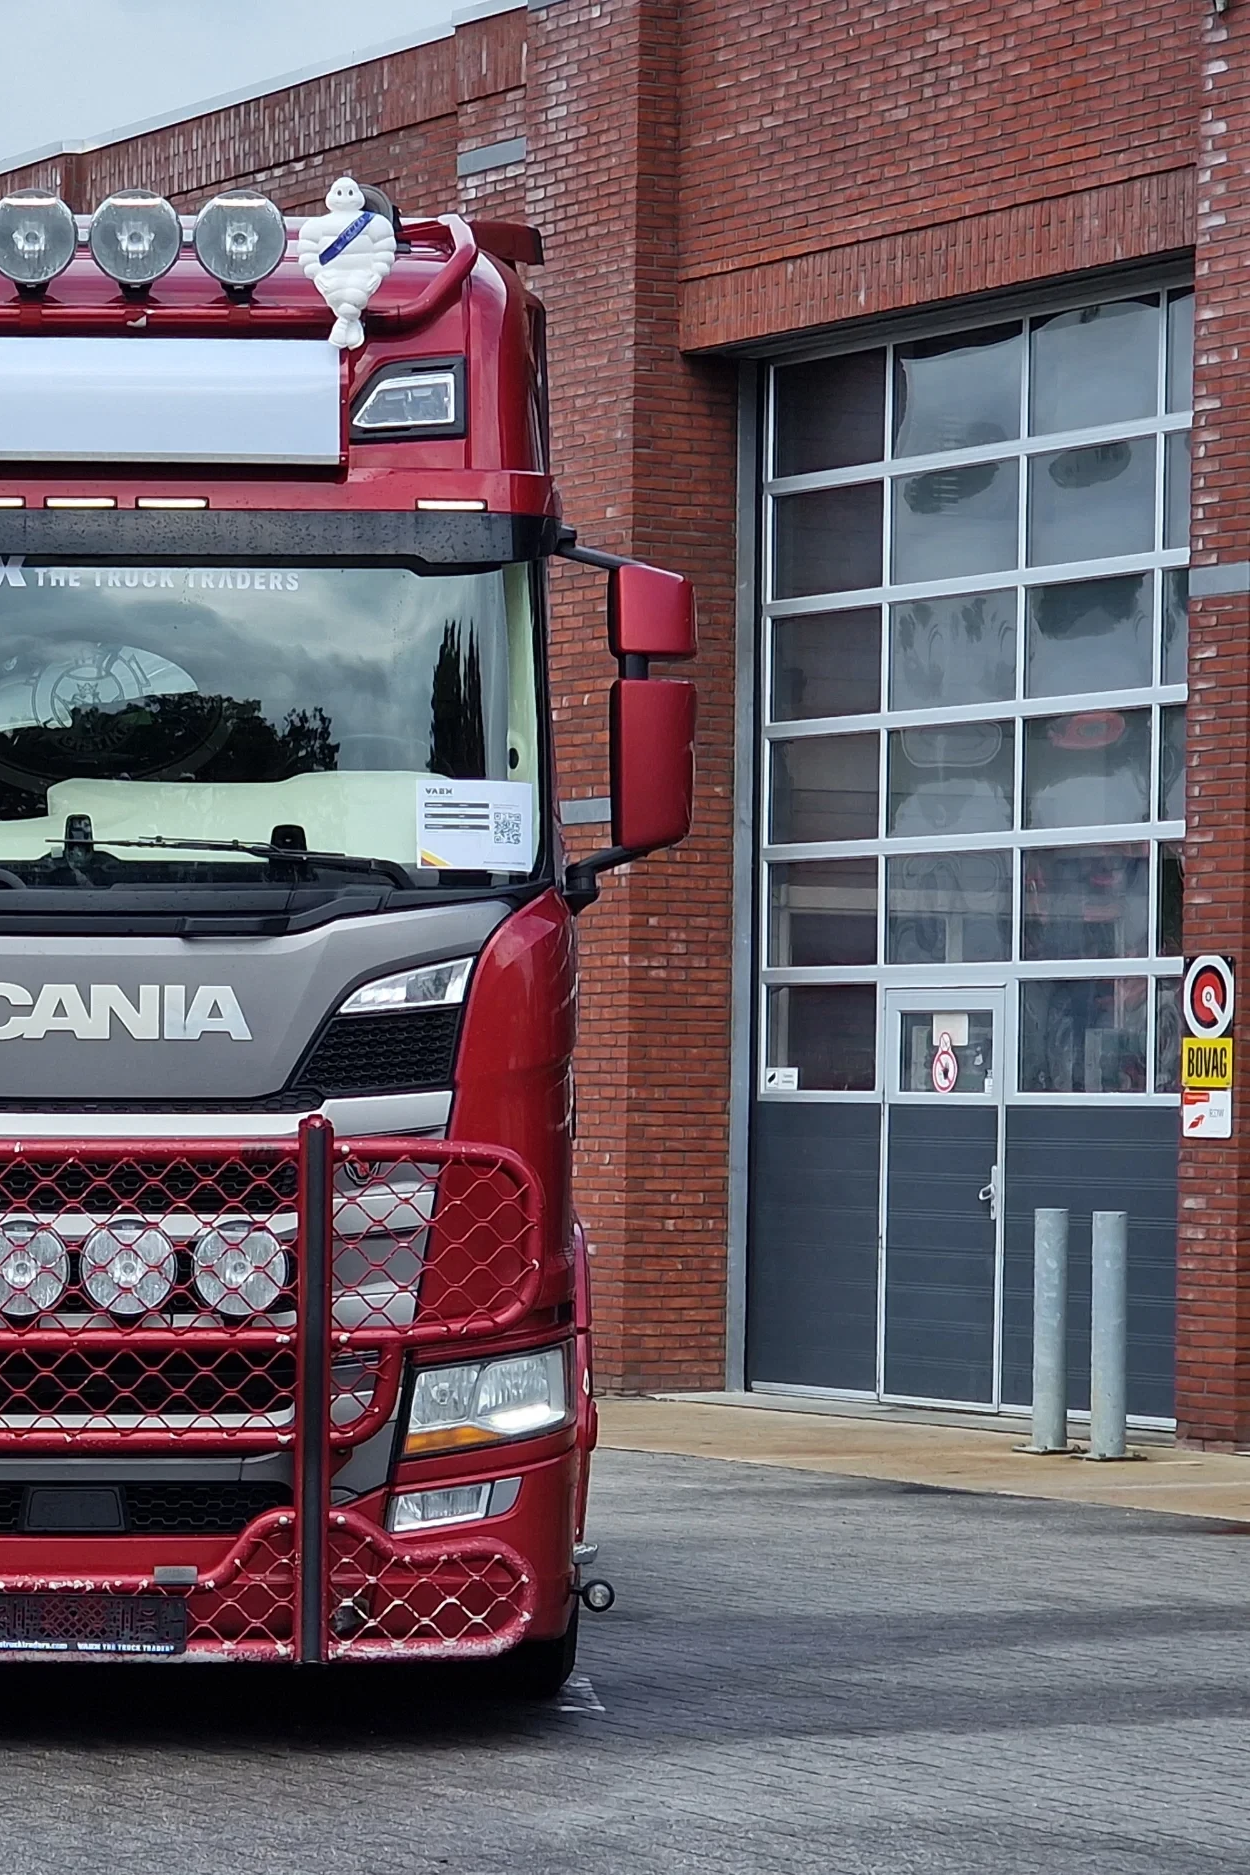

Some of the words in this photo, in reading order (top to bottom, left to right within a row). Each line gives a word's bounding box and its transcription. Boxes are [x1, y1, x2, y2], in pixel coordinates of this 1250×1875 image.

[35, 568, 81, 587] THE
[93, 570, 175, 588] TRUCK
[186, 571, 300, 591] TRADERS
[425, 787, 453, 796] VAEX
[1187, 1047, 1228, 1078] BOVAG
